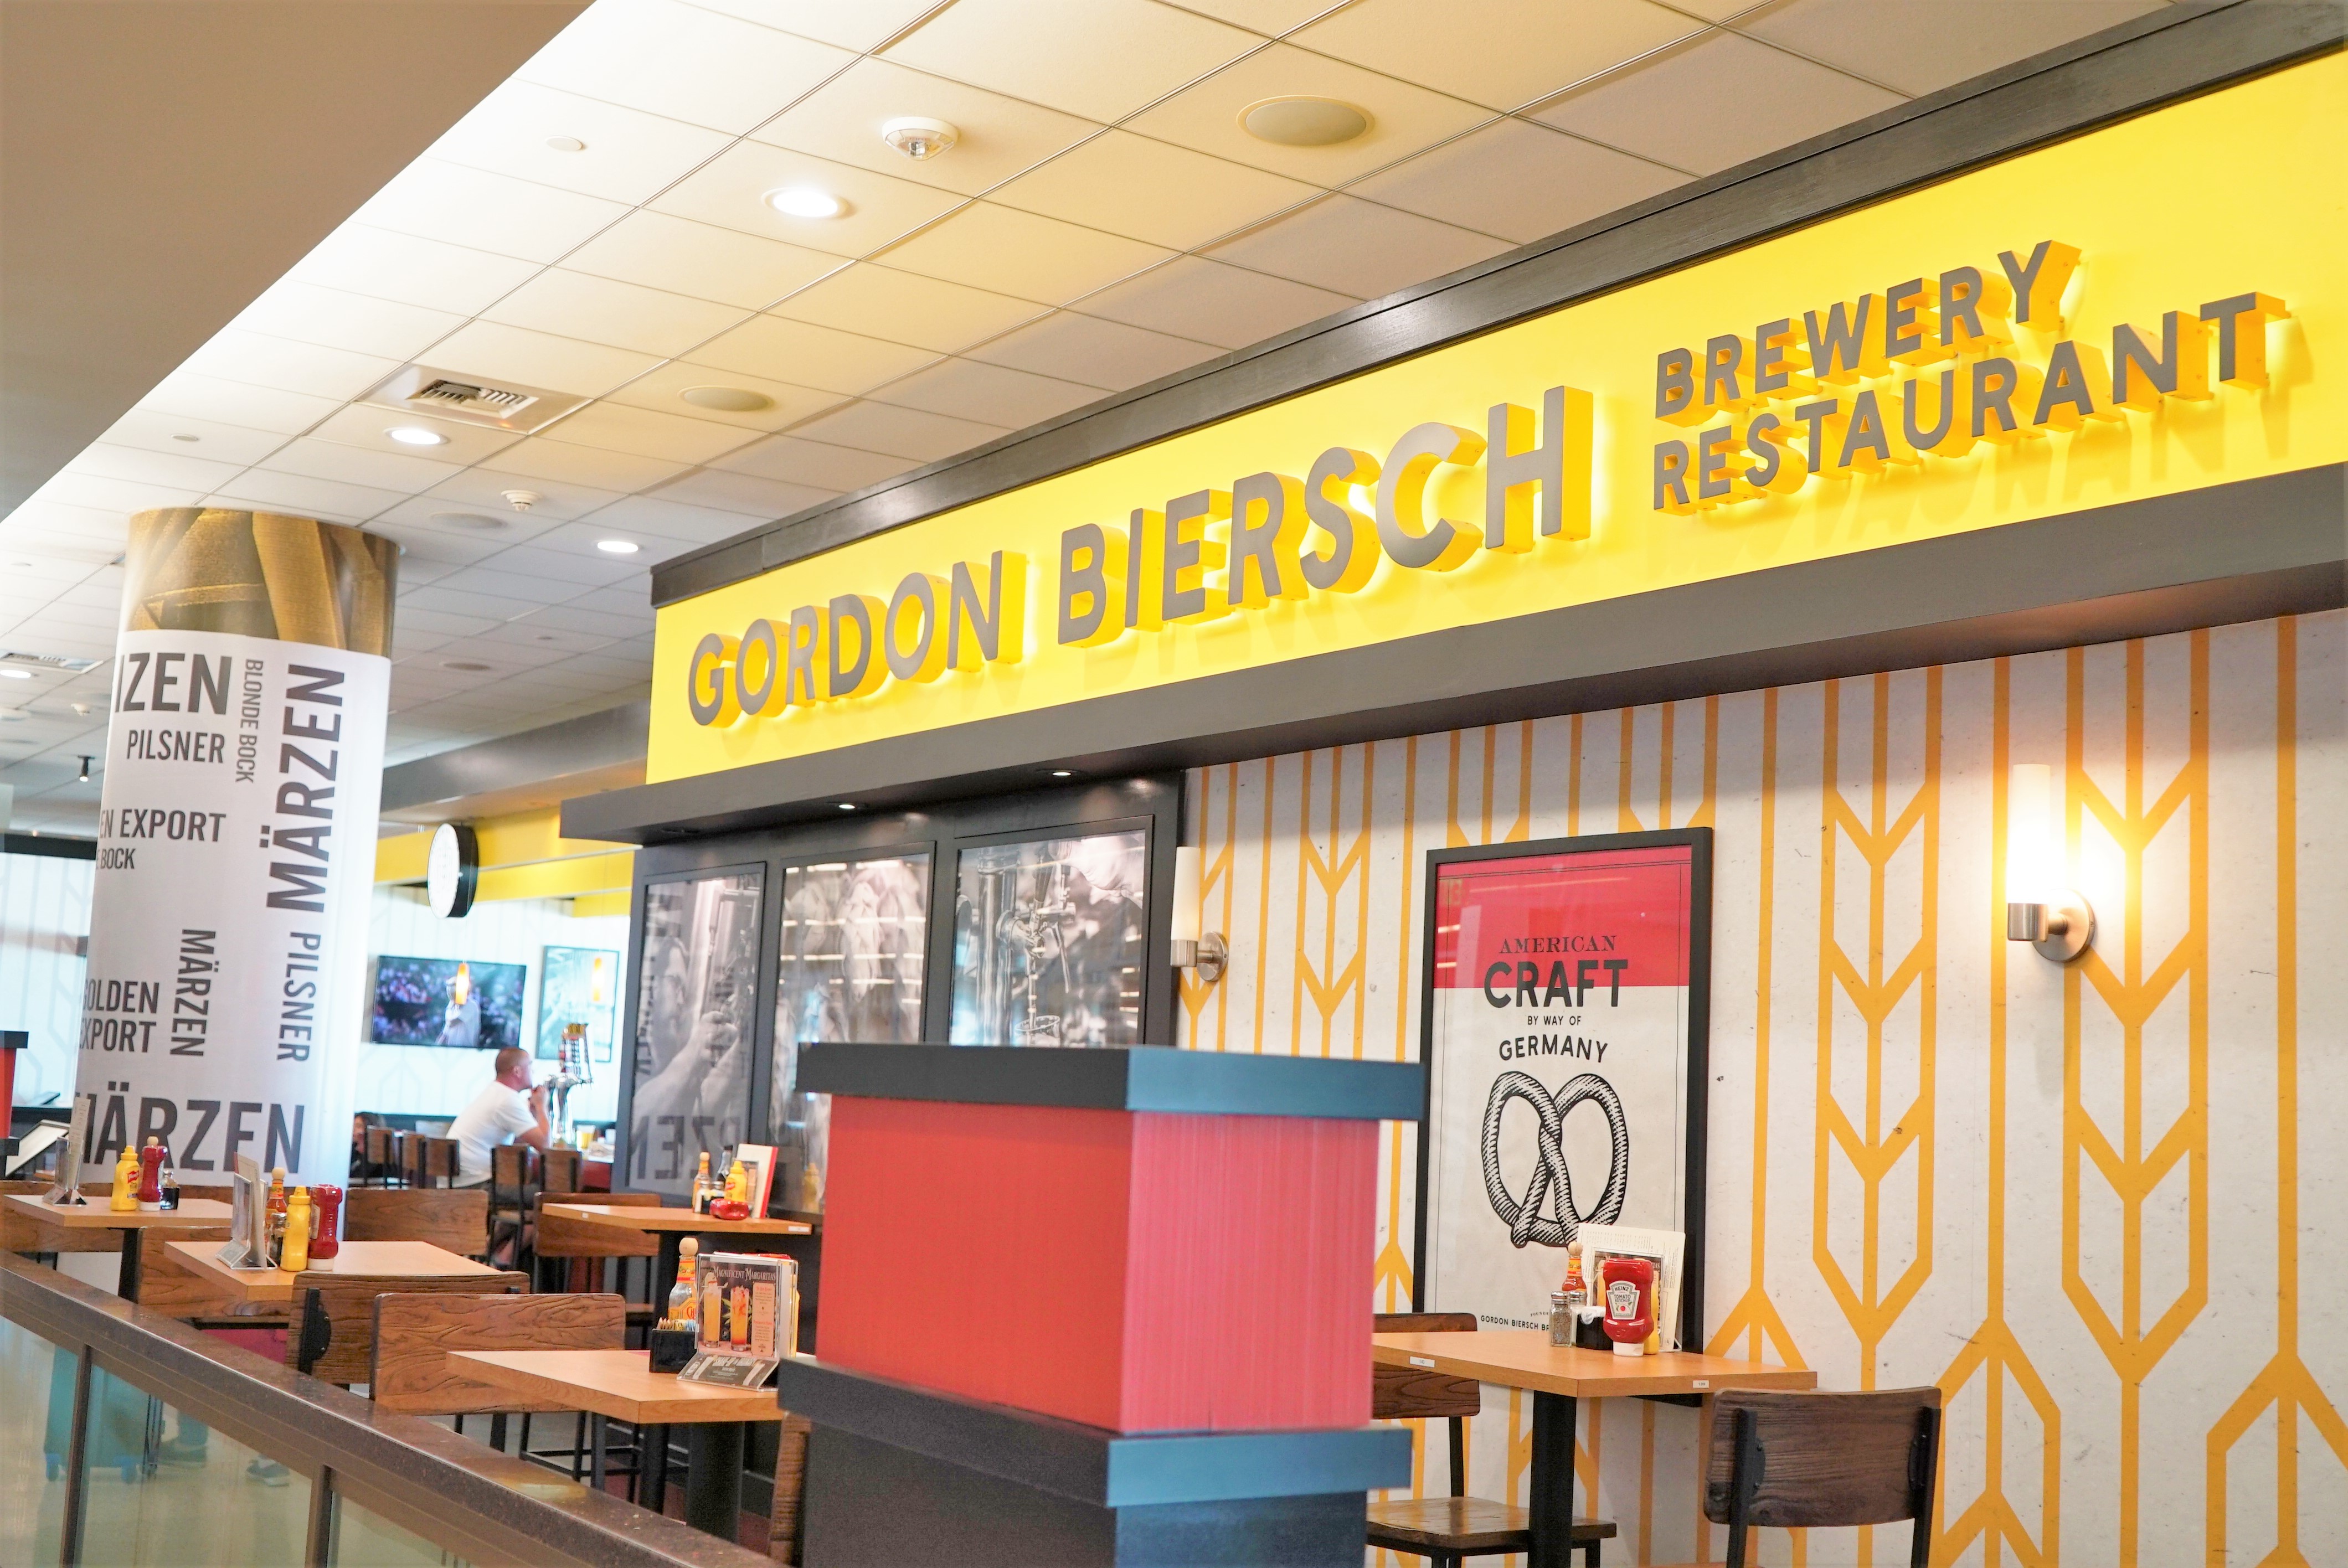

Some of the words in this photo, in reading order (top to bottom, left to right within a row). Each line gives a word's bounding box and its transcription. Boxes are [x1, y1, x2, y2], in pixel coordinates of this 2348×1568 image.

[1655, 240, 2053, 420] BREWERY
[1654, 292, 2258, 510] RESTAURANT
[688, 549, 1007, 727] GORDON
[1058, 385, 1568, 647] BIERSCH
[240, 658, 264, 730] BLONDE
[126, 729, 225, 764] PILSNER
[235, 734, 258, 783] BOCK
[259, 663, 345, 913] MÄRZEN
[120, 808, 226, 842] EXPORT
[101, 848, 136, 870] BOCK
[1499, 935, 1617, 954] AMERICAN
[169, 929, 219, 1056] MÄRZEN
[277, 931, 321, 1062] PILSNER
[1484, 959, 1628, 1008] CRAFT
[1527, 1015, 1538, 1025] BY
[1543, 1015, 1563, 1025] WAY
[1569, 1015, 1582, 1025] OF
[1499, 1034, 1608, 1063] GERMANY
[713, 1266, 745, 1280] MAGNIFICENT
[745, 1267, 776, 1281] MARGARITAS
[1481, 1315, 1508, 1325] GORDON
[1511, 1319, 1538, 1330] BIERSCH
